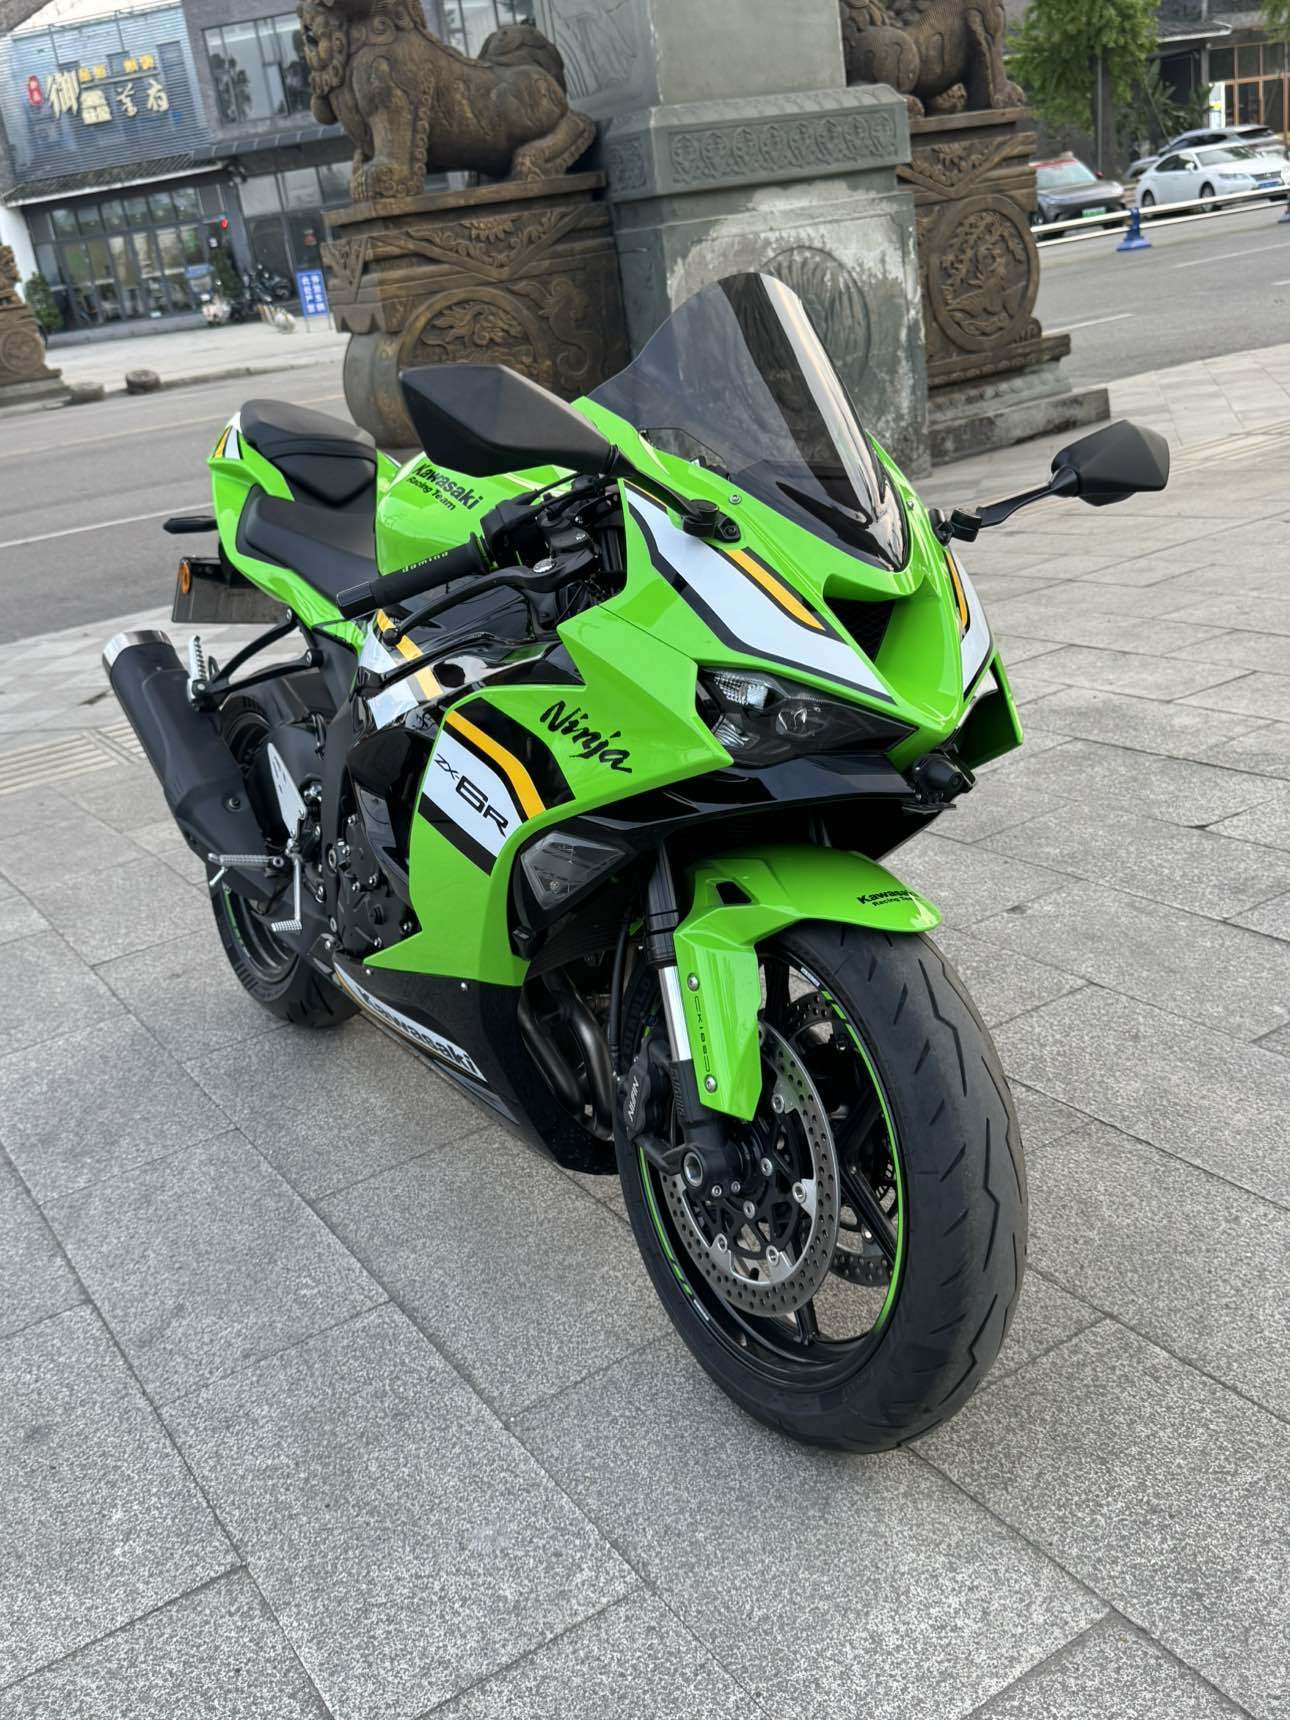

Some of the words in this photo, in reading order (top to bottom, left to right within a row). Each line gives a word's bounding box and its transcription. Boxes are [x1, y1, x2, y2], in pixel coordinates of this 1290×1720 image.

[413, 463, 484, 511] Kawasaki
[432, 488, 456, 511] Team
[540, 700, 633, 774] Ninja
